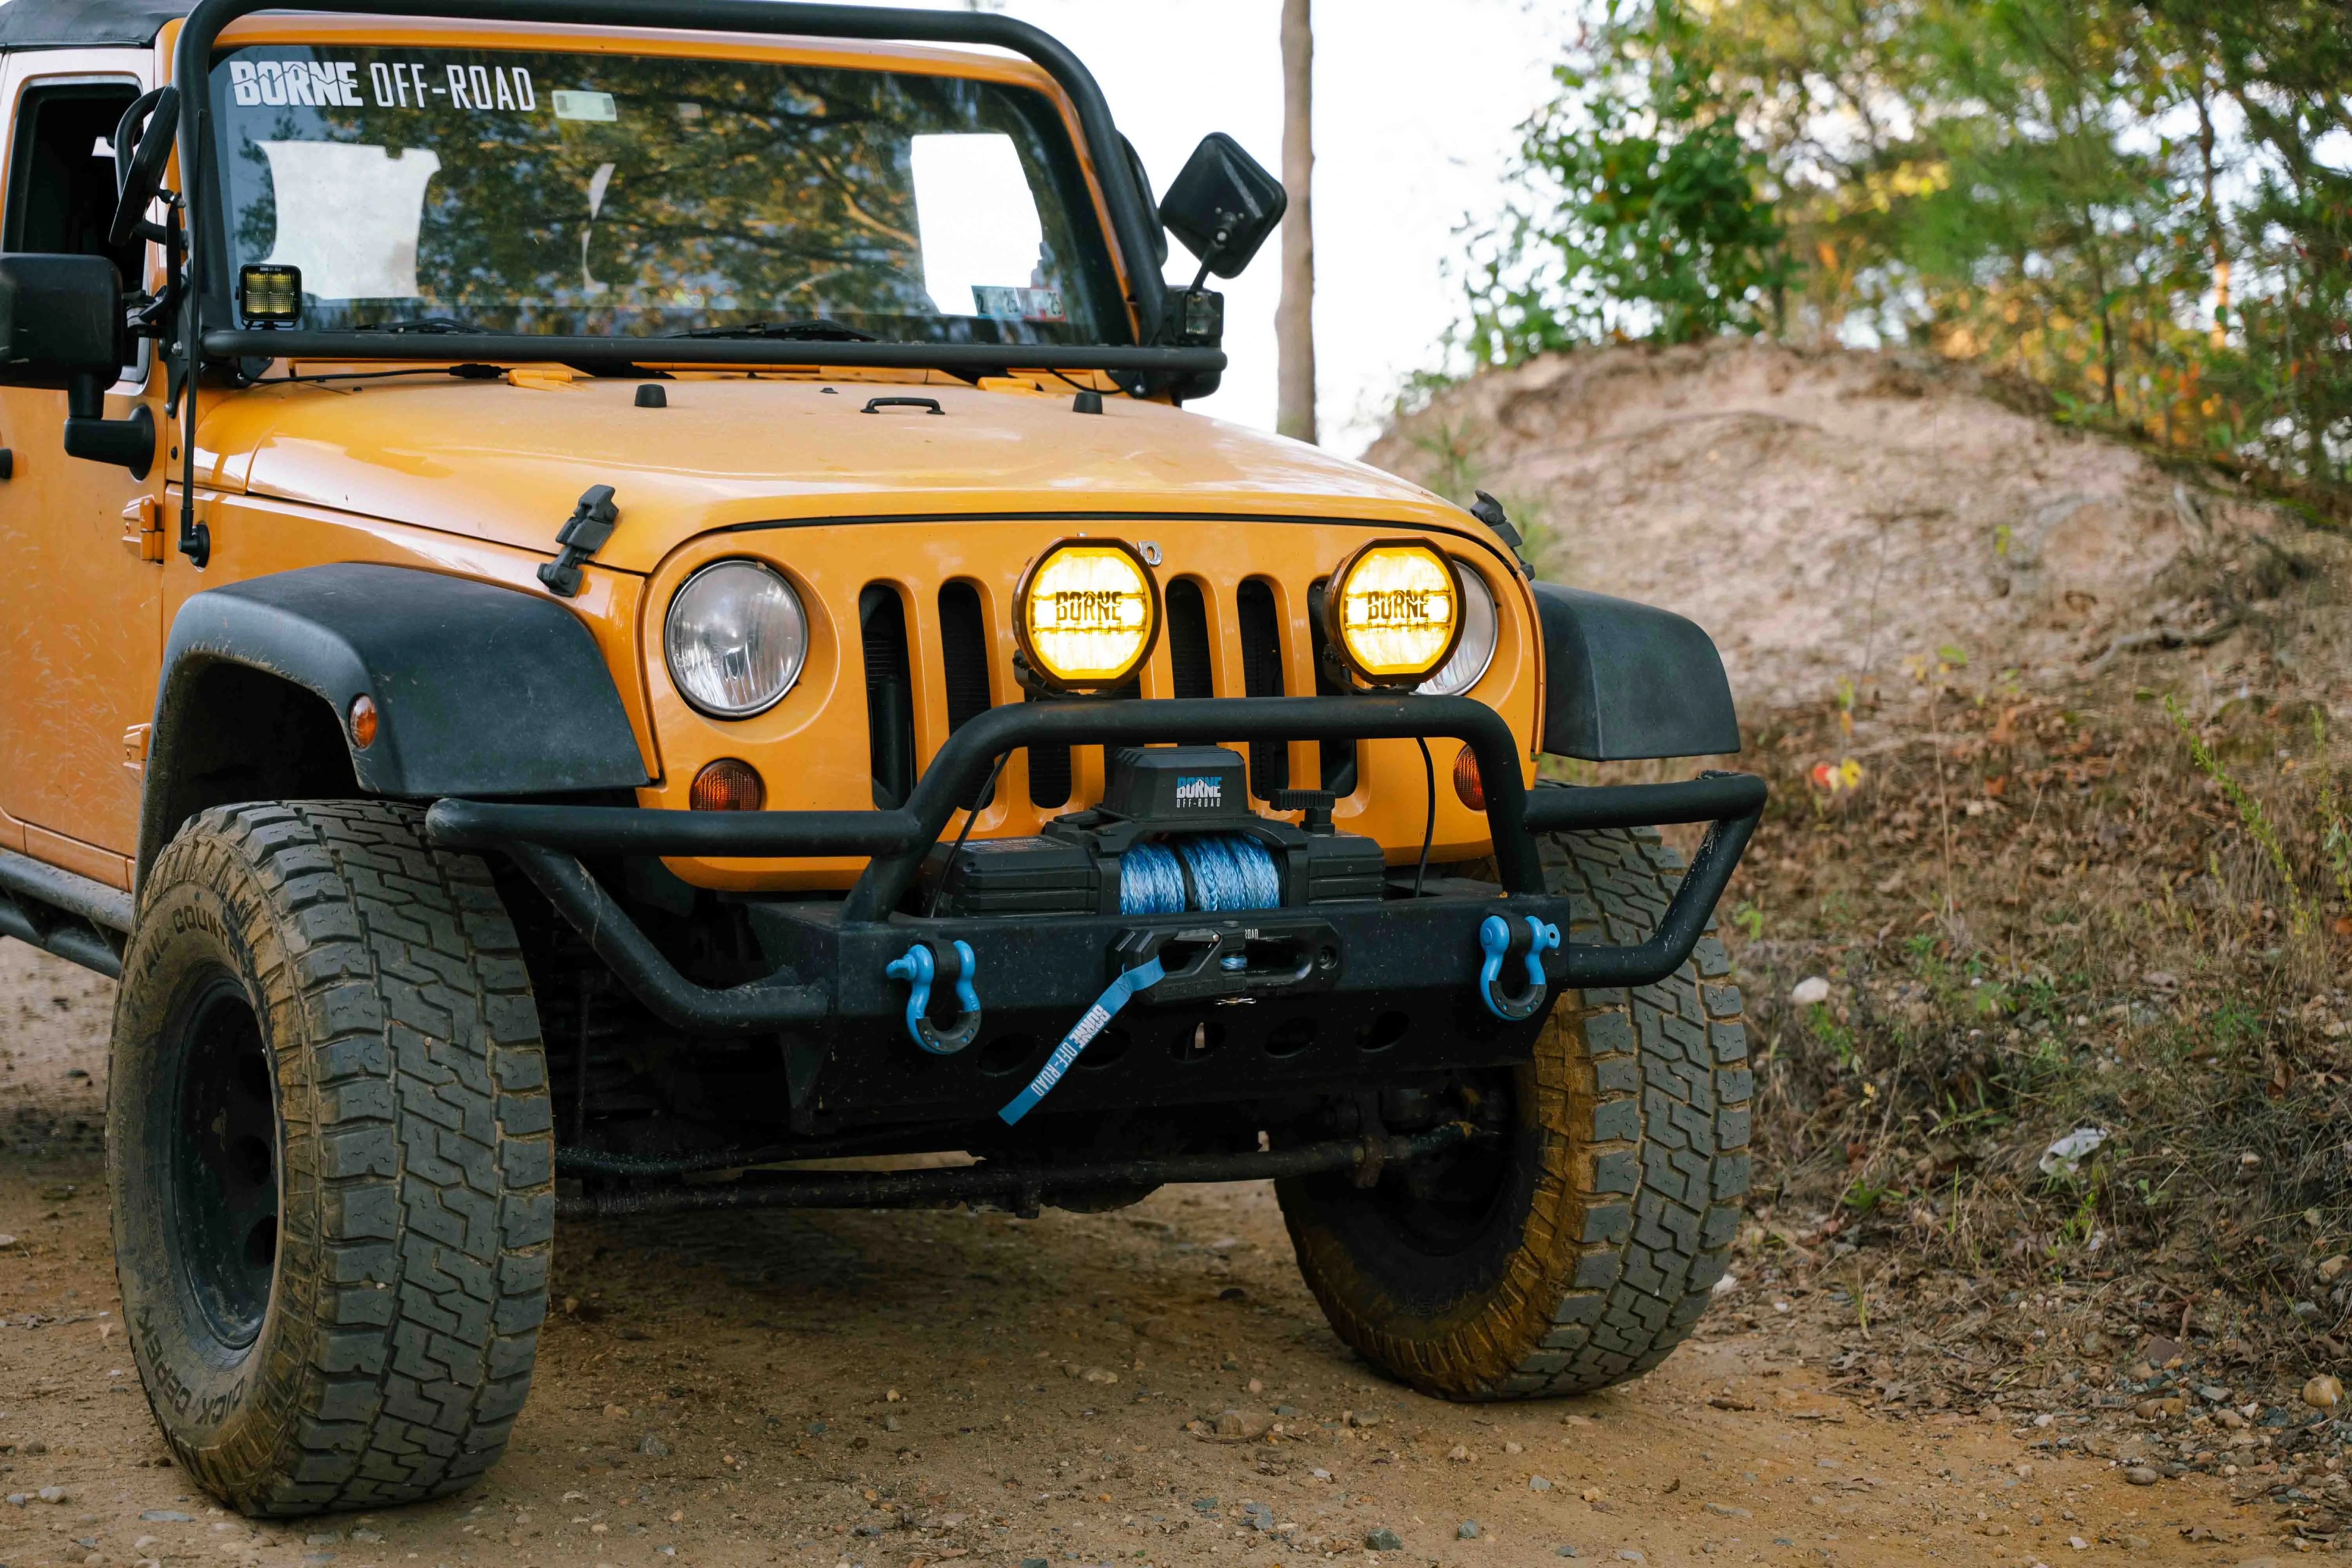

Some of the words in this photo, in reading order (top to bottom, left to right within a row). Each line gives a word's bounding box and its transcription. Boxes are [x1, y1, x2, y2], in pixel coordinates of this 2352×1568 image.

[229, 61, 363, 106] BORNE
[370, 63, 536, 111] OFF-ROAD
[1056, 591, 1122, 621] BORNE
[1368, 589, 1429, 620] BORNE
[1176, 777, 1222, 798] BORNE
[1176, 798, 1220, 808] OFF-ROAD
[1069, 1004, 1112, 1049] BORNE
[1031, 1042, 1078, 1096] OFF-ROAD
[135, 1308, 192, 1417] CEPEK
[195, 1374, 245, 1424] DICK
